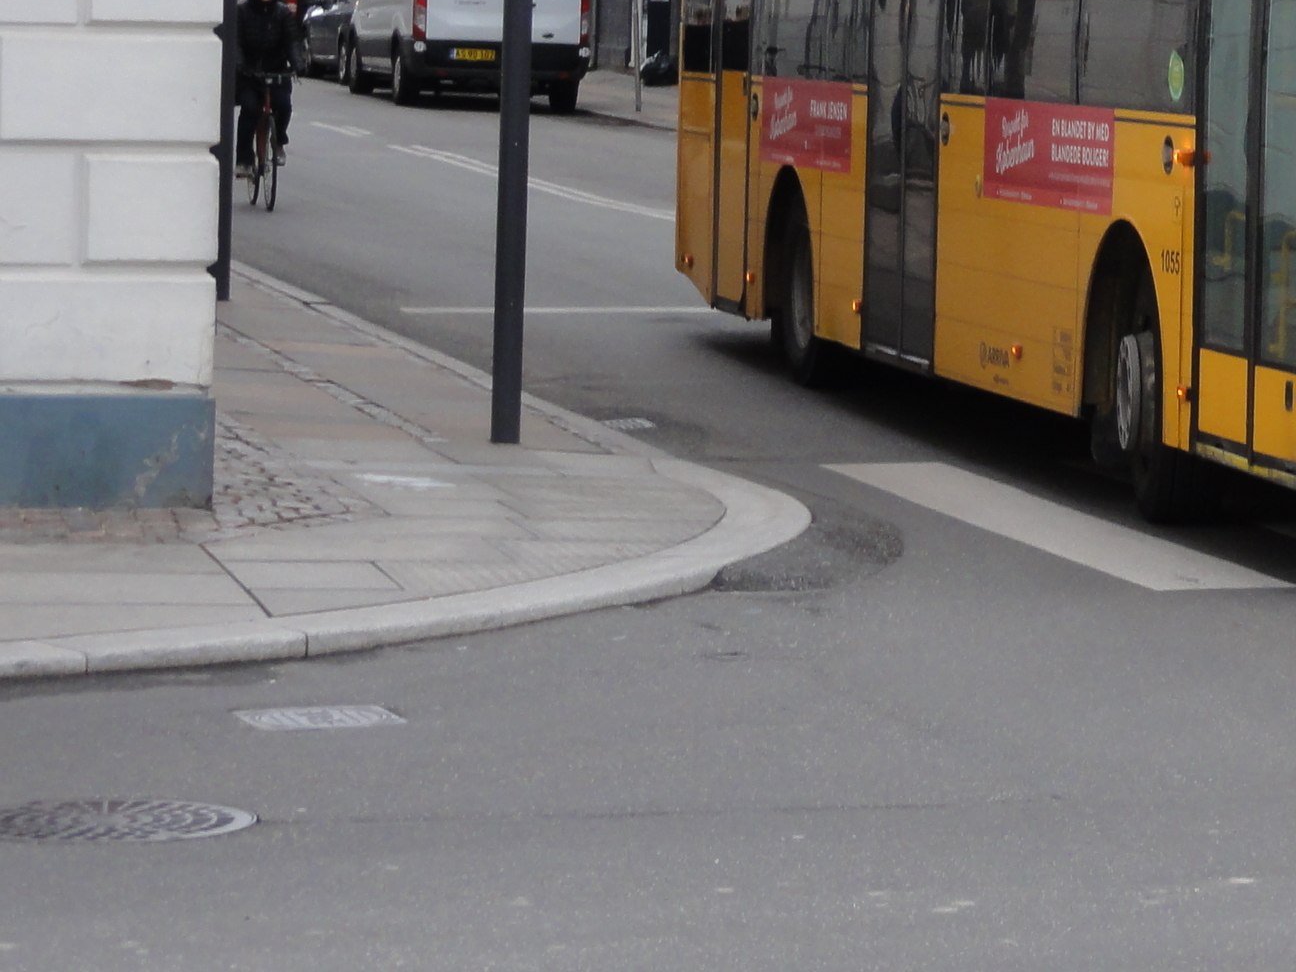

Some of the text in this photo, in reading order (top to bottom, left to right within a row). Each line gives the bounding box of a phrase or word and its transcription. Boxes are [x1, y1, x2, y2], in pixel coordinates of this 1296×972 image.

[1051, 118, 1110, 142] EN BLANDET BY MED
[1051, 143, 1081, 164] BLANDEDE
[1160, 248, 1181, 275] 1055
